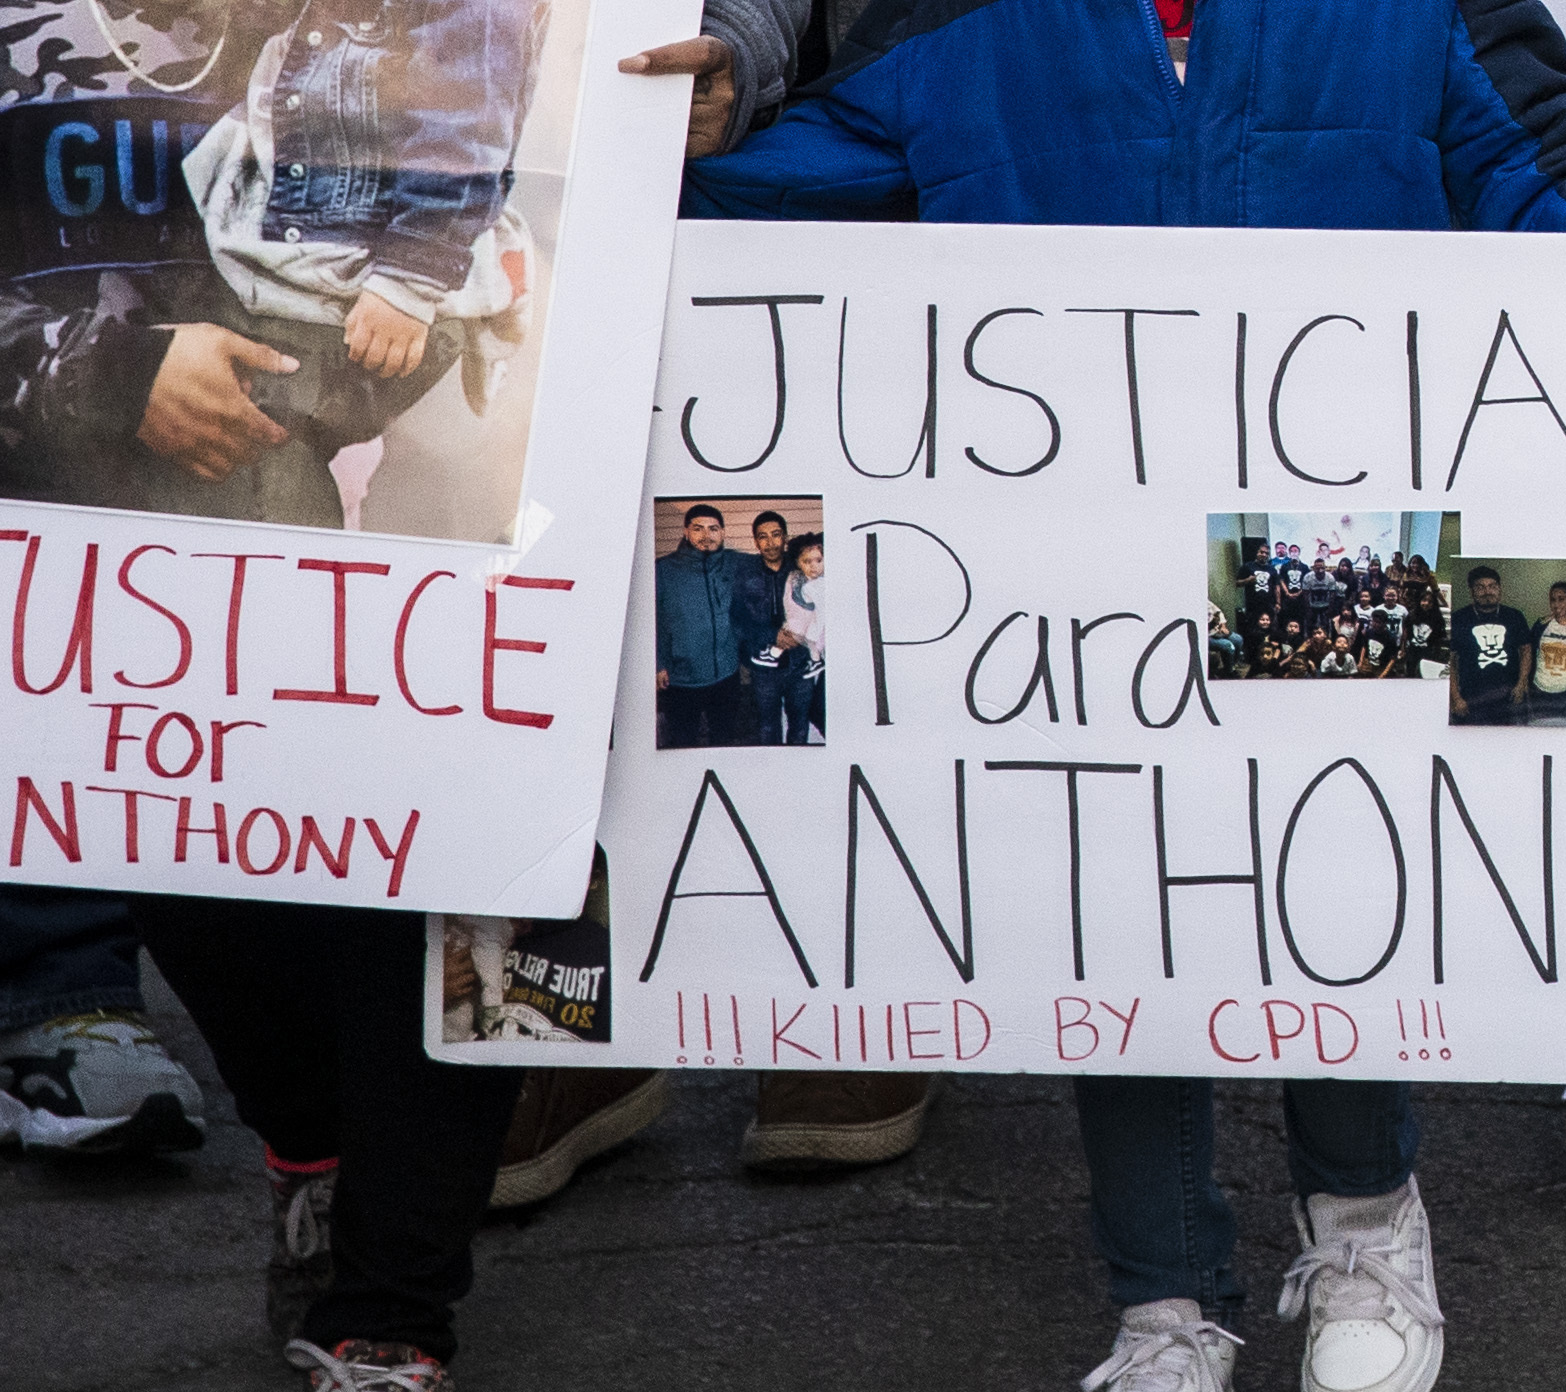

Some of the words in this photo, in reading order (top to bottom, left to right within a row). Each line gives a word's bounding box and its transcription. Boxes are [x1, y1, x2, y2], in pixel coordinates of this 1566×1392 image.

[44, 119, 214, 217] GU
[0, 530, 574, 729] USTICE
[849, 518, 1222, 731] Para
[10, 777, 420, 897] NTHONY
[1054, 997, 1140, 1062] BY
[1208, 999, 1358, 1065] CPD
[1396, 1000, 1452, 1061] !!!
